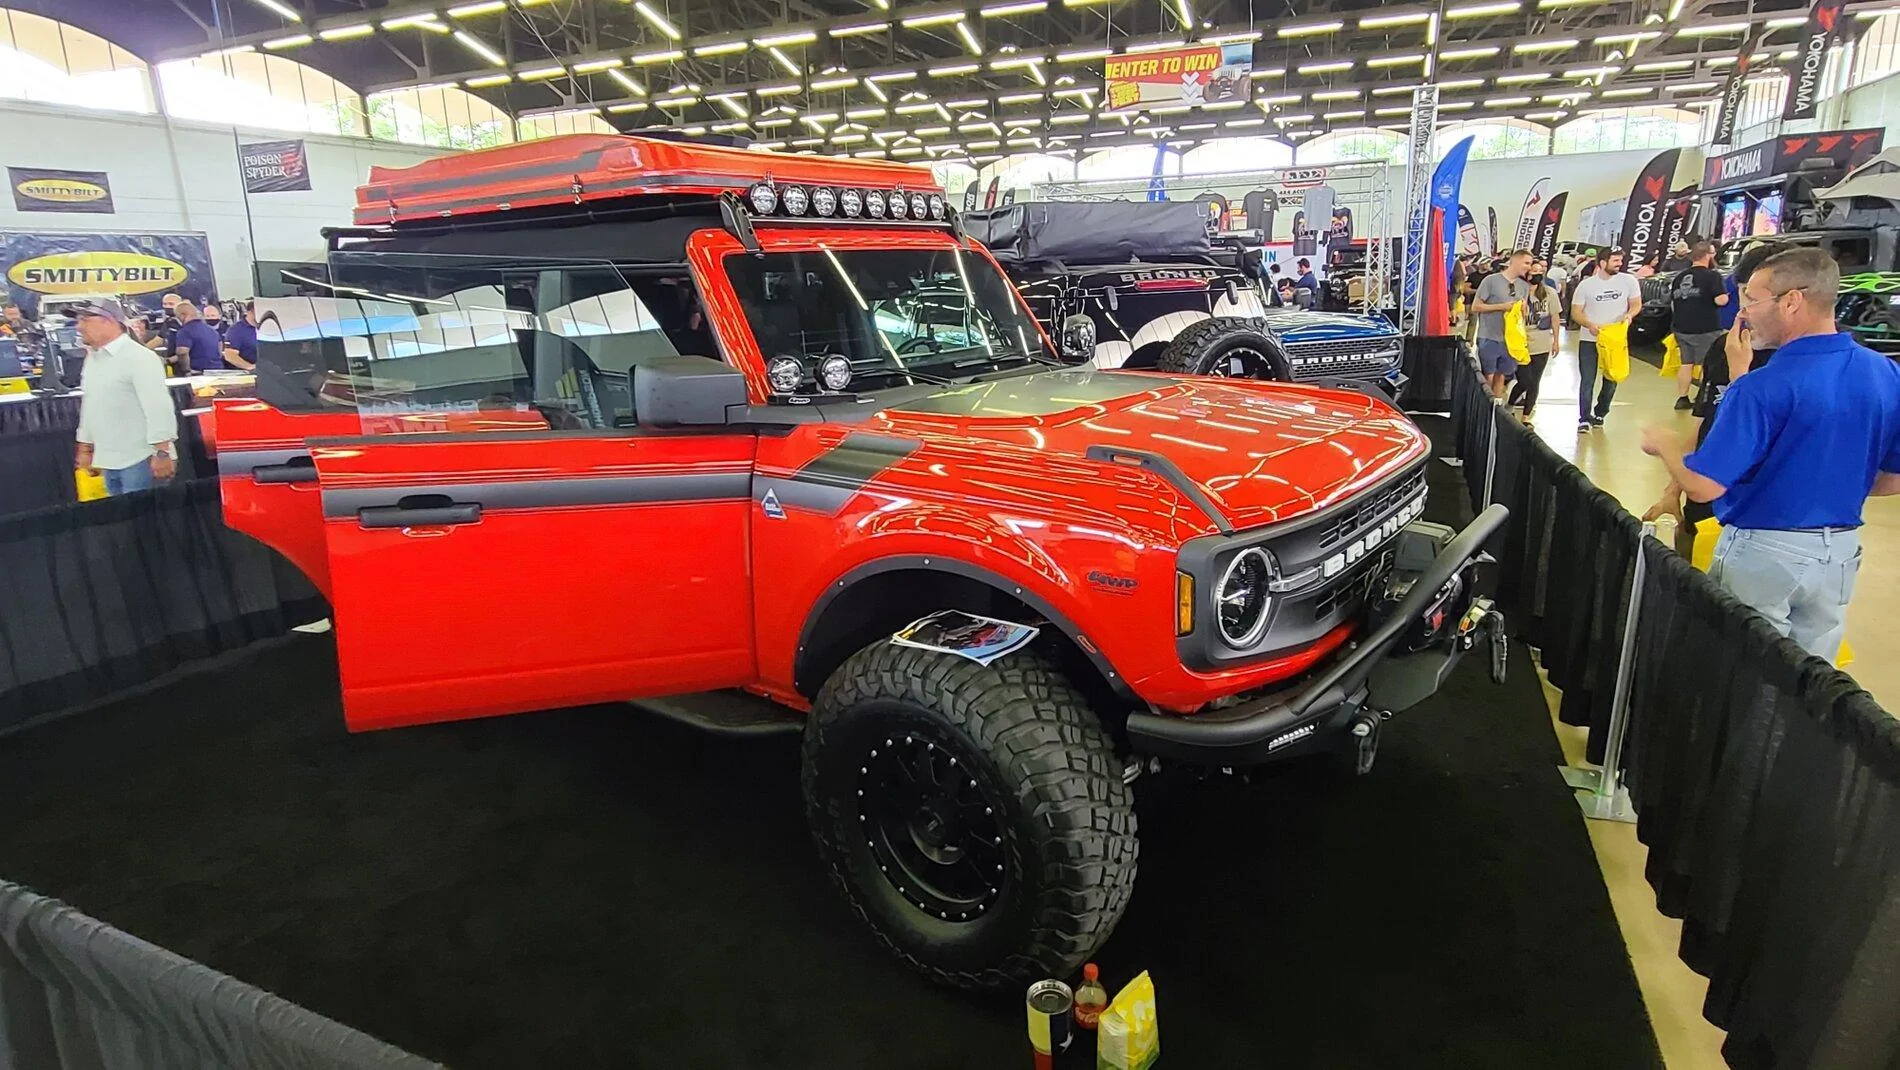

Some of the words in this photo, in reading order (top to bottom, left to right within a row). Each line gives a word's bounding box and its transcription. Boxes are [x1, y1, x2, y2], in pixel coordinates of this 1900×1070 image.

[1162, 58, 1182, 74] TO
[1184, 53, 1218, 71] WIN
[1794, 31, 1828, 113] YOKOHAMA
[1719, 74, 1742, 139] YOKOHAMA
[244, 153, 282, 167] POISON
[1720, 148, 1762, 180] YOKOHAMA
[246, 166, 289, 179] SPYDER
[25, 185, 101, 197] SMITTYBILT
[25, 265, 175, 284] SMITTYBILT
[1120, 269, 1218, 282] BRONCO
[1291, 353, 1375, 365] BRONCO
[1324, 496, 1424, 578] BRONCO
